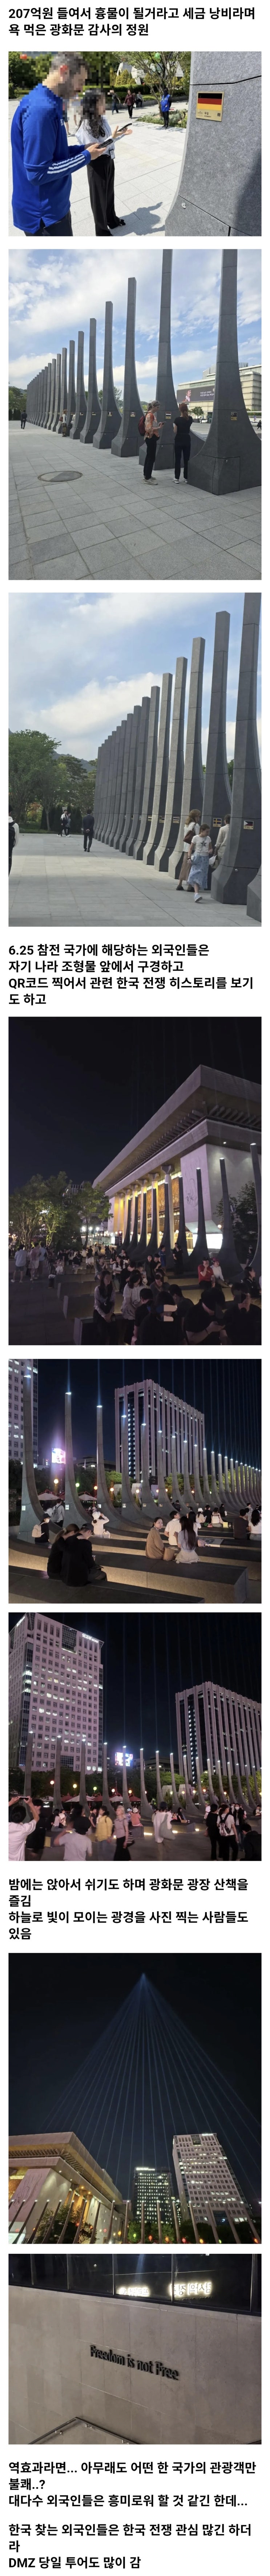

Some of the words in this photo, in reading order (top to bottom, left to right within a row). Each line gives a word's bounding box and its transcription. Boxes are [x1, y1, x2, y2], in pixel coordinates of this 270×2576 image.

[90, 2345, 125, 2366] Freedom
[126, 2354, 135, 2368] is
[136, 2360, 154, 2374] not
[155, 2361, 179, 2380] Free
